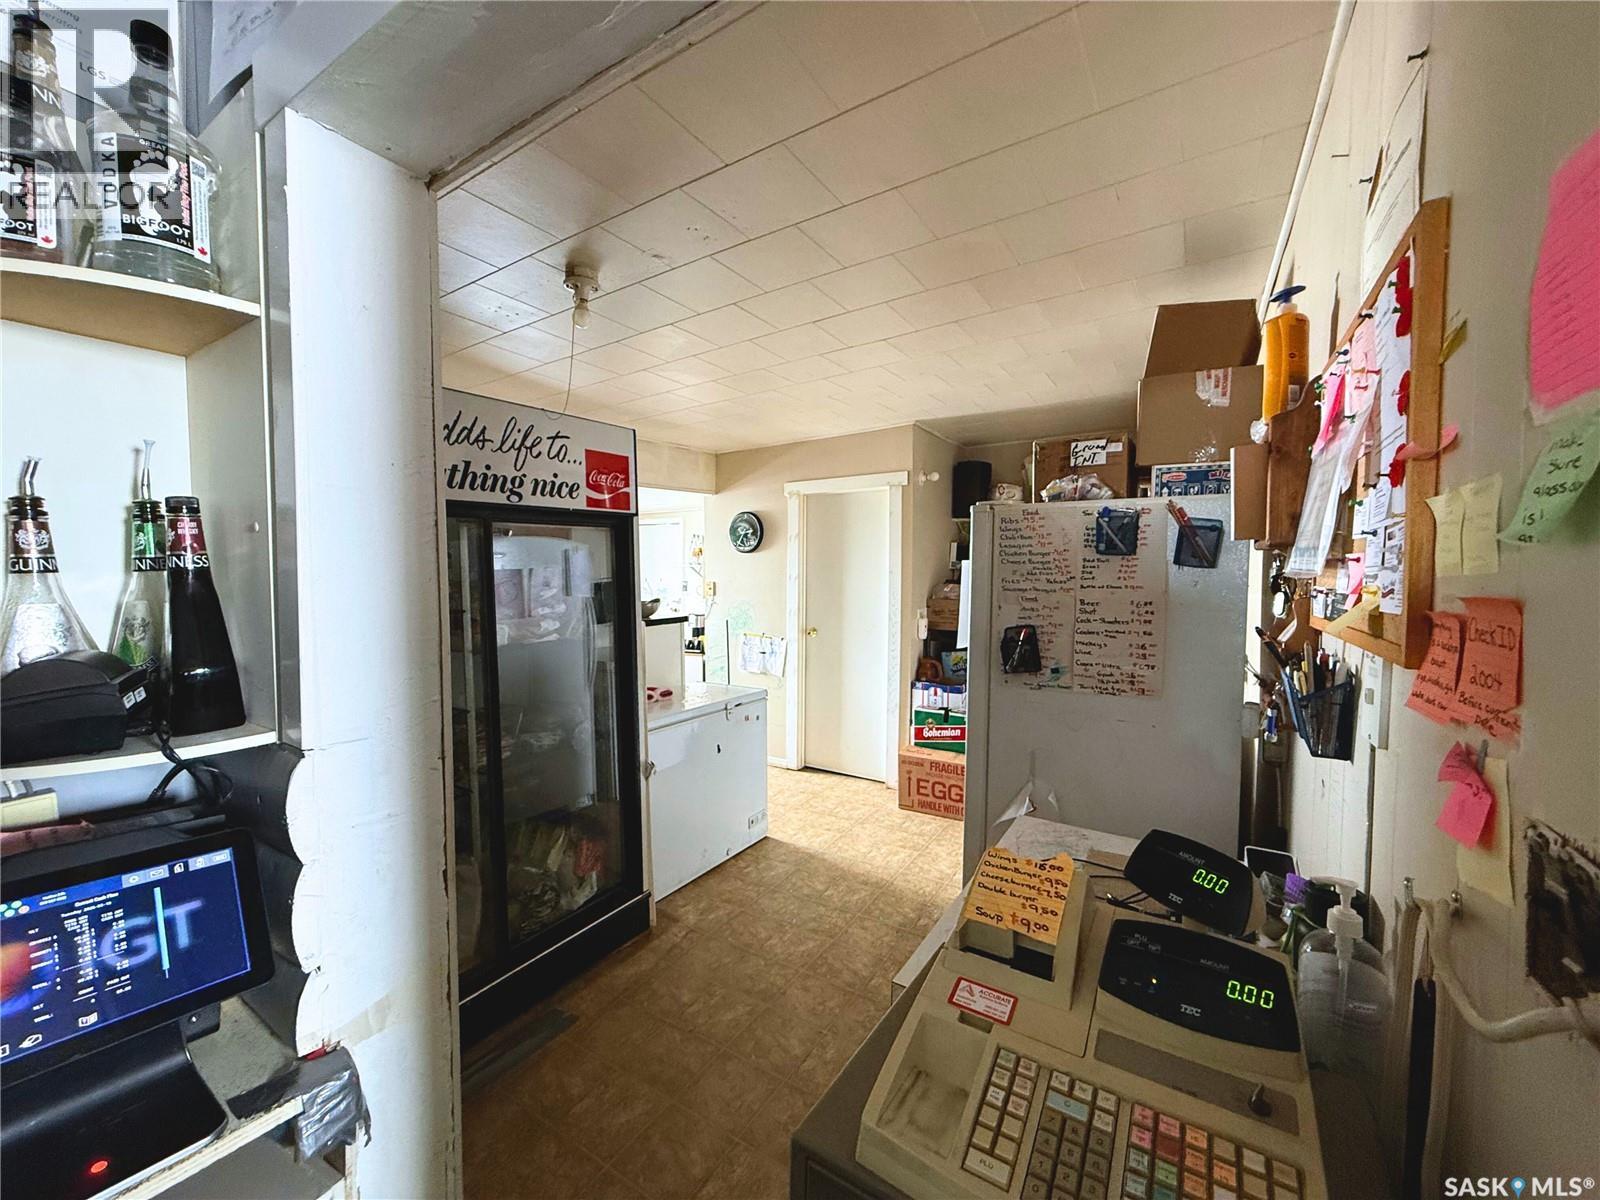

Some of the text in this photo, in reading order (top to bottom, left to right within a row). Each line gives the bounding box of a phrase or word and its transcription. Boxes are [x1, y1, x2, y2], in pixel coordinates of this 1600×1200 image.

[101, 136, 118, 209] VODKA
[122, 213, 191, 238] BIGFOOT
[491, 416, 542, 472] life
[446, 460, 581, 503] thing nice
[1079, 598, 1100, 607] Beer
[922, 727, 961, 738] Bohemian
[930, 761, 966, 777] FRAGILE
[987, 850, 1018, 864] Wings
[1192, 868, 1230, 894] 0.00
[1168, 892, 1184, 904] TEC
[975, 905, 1004, 924] Soup
[1226, 979, 1275, 1009] 0.00
[1180, 1003, 1202, 1017] TEC
